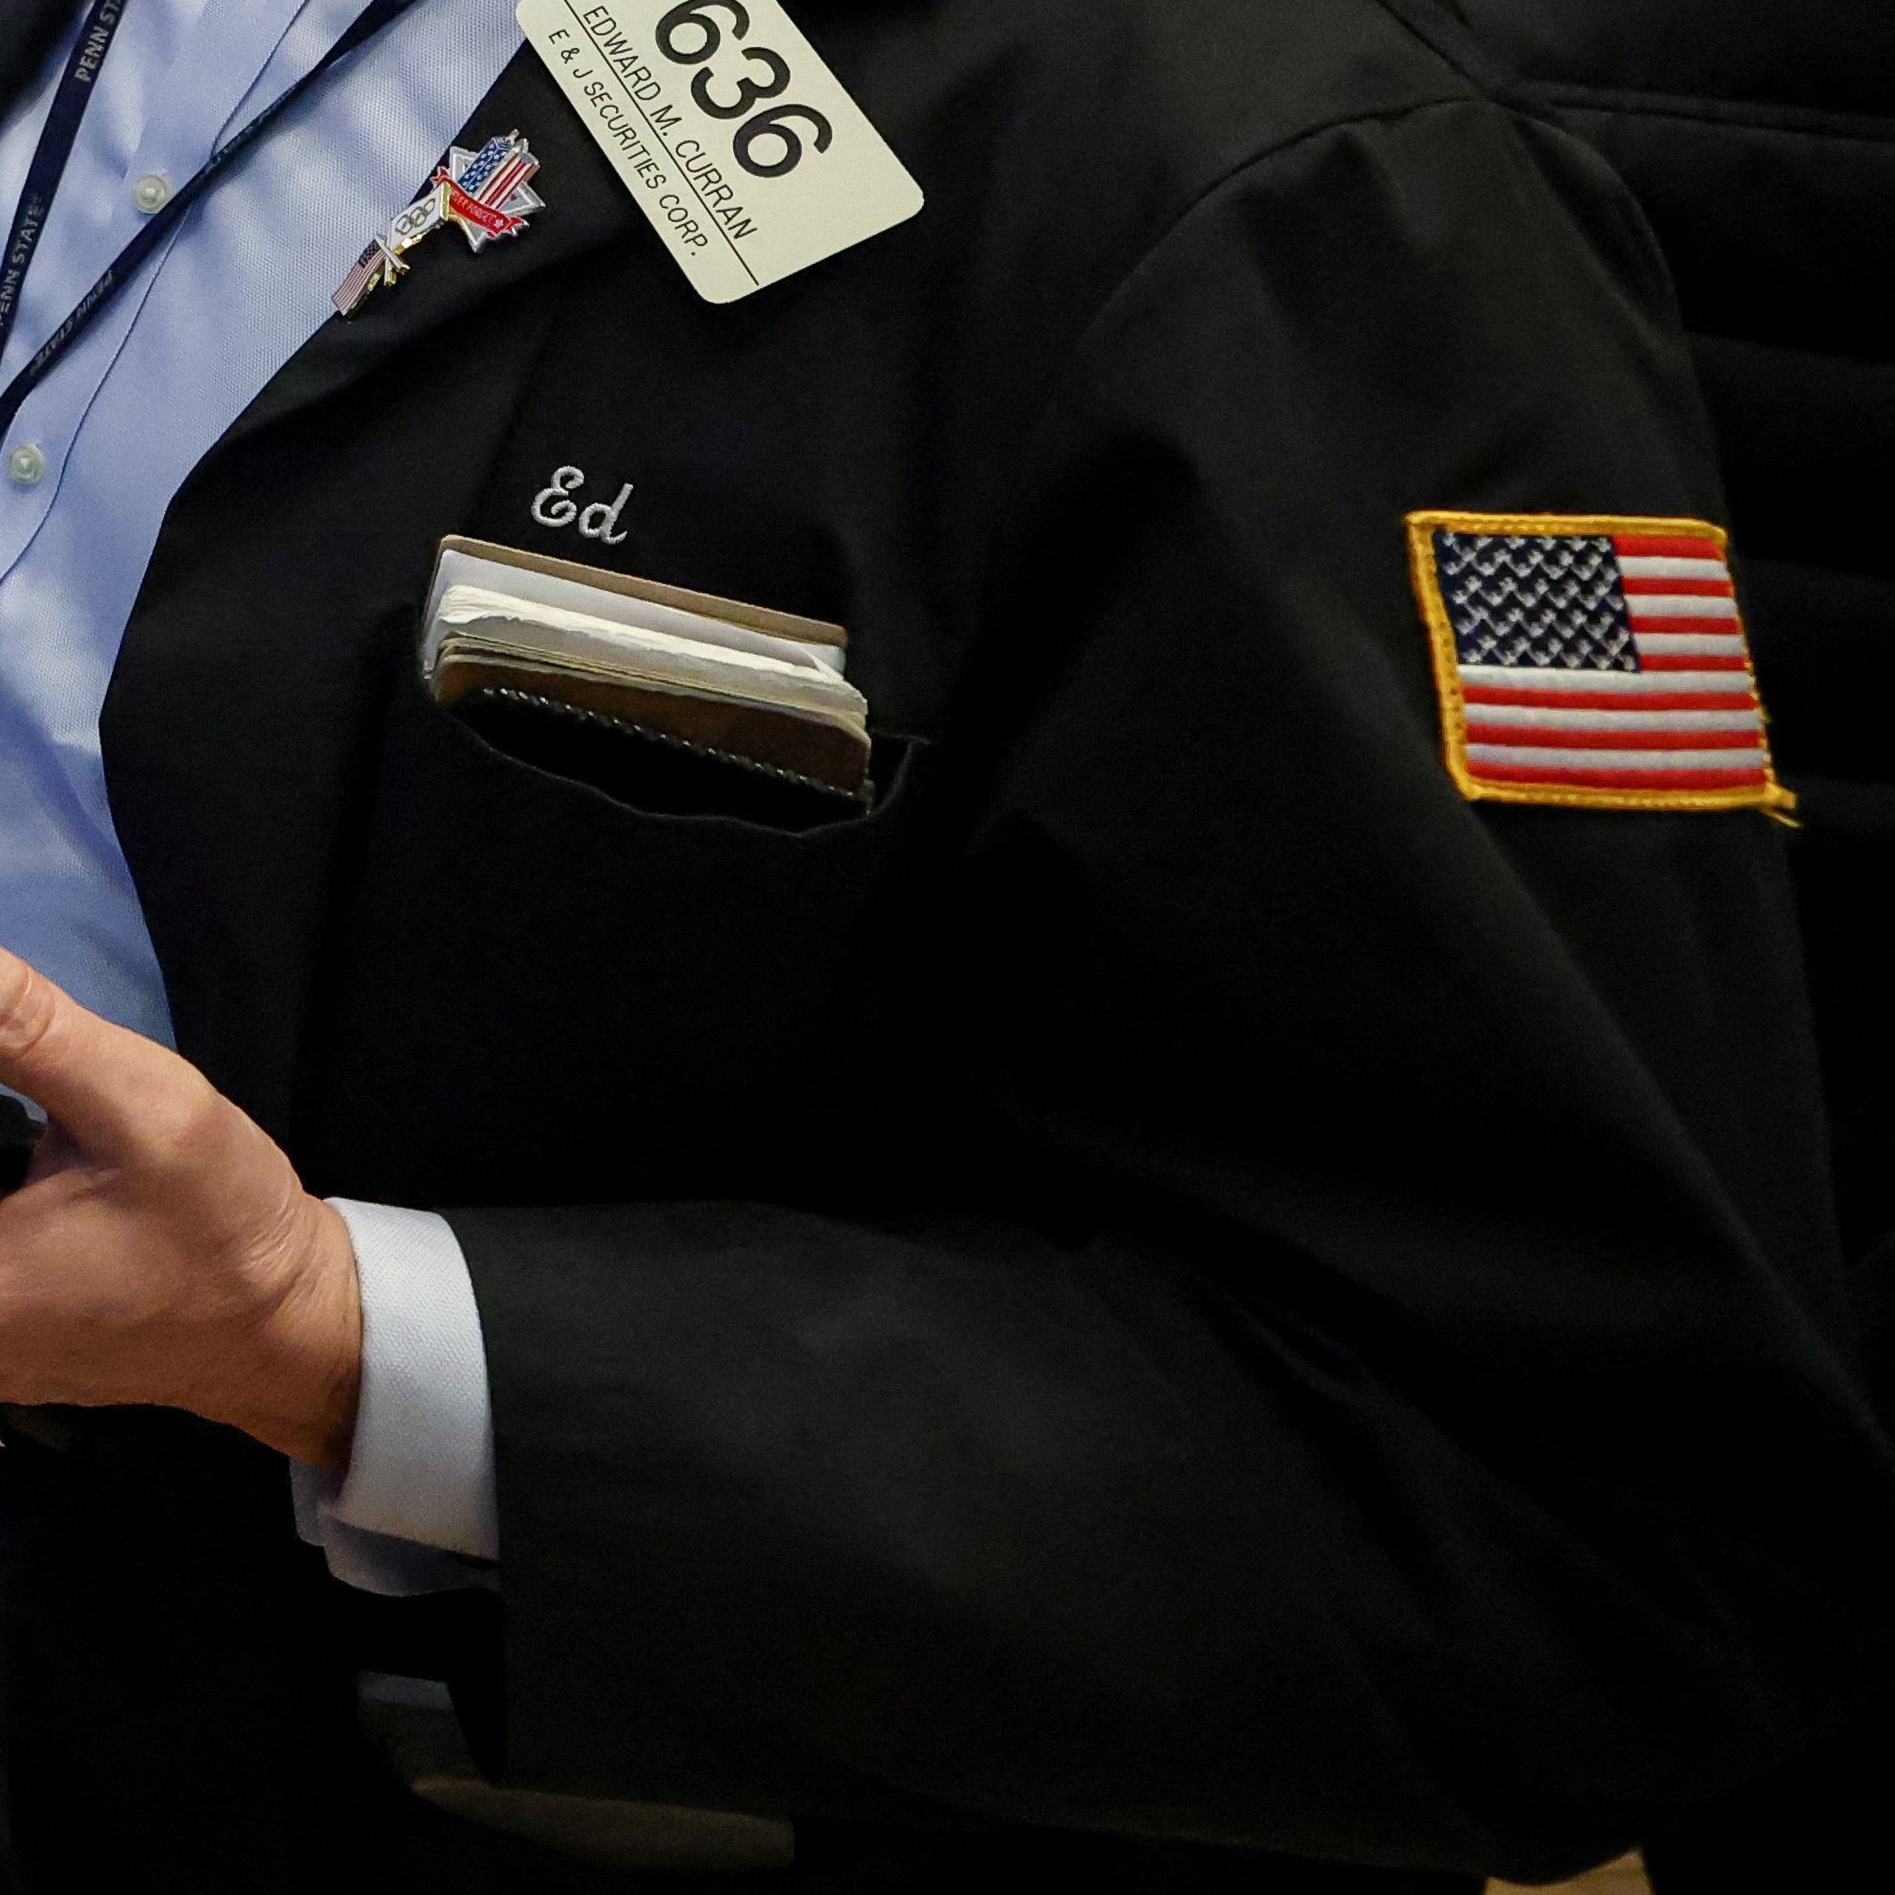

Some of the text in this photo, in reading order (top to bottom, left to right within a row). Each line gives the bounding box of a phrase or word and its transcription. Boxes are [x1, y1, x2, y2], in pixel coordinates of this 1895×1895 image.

[74, 25, 110, 82] PENN
[582, 5, 759, 240] EDWARD M. CURRAN
[548, 28, 709, 257] E & J SECURITIES CORP.
[530, 465, 635, 546] Ed
